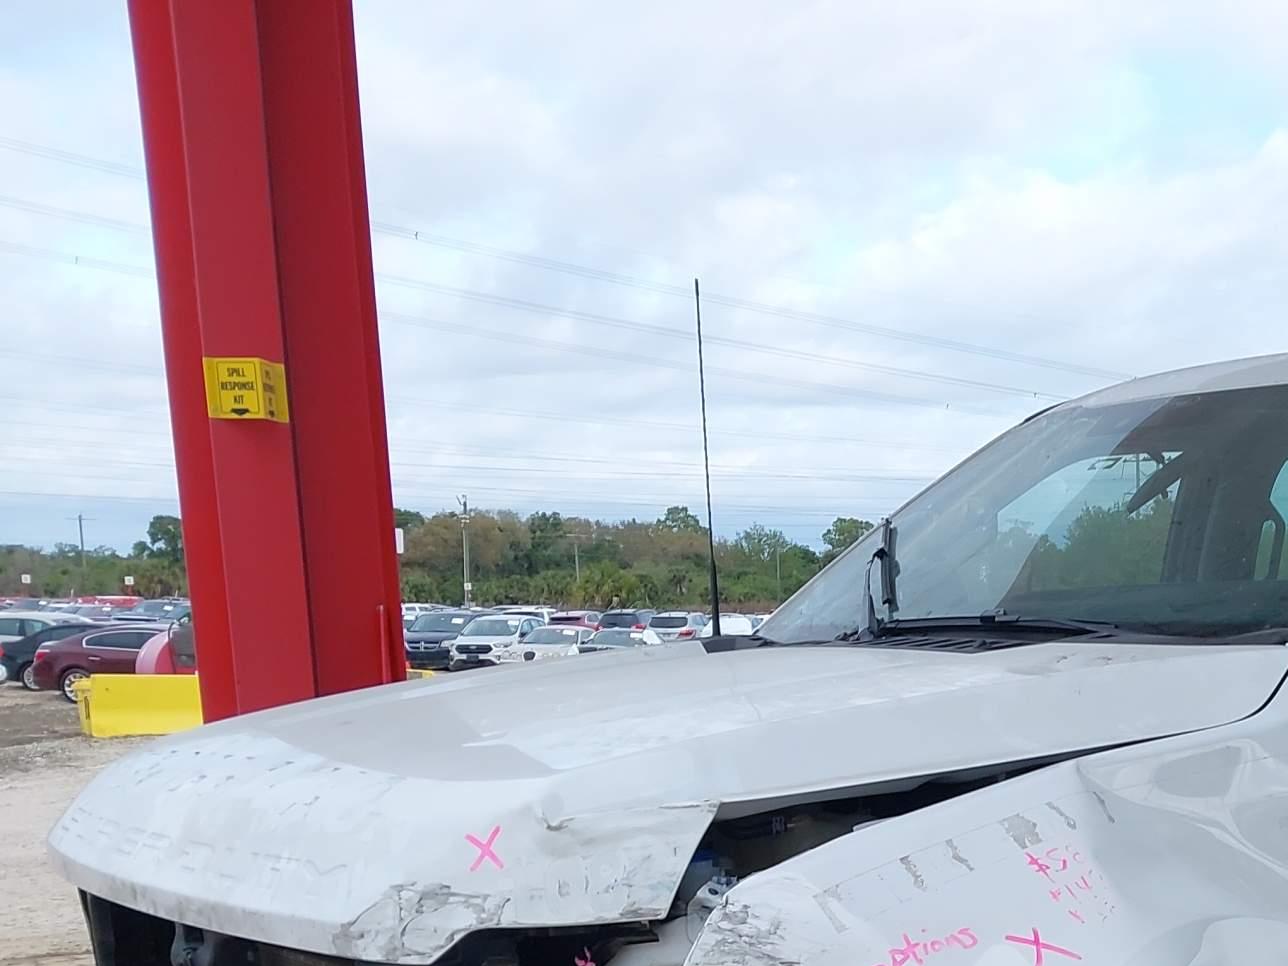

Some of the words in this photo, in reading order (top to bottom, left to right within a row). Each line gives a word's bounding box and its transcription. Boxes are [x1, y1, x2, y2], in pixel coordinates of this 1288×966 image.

[227, 368, 246, 377] SPILL
[220, 381, 256, 391] RESPONSE
[233, 394, 244, 404] KIT
